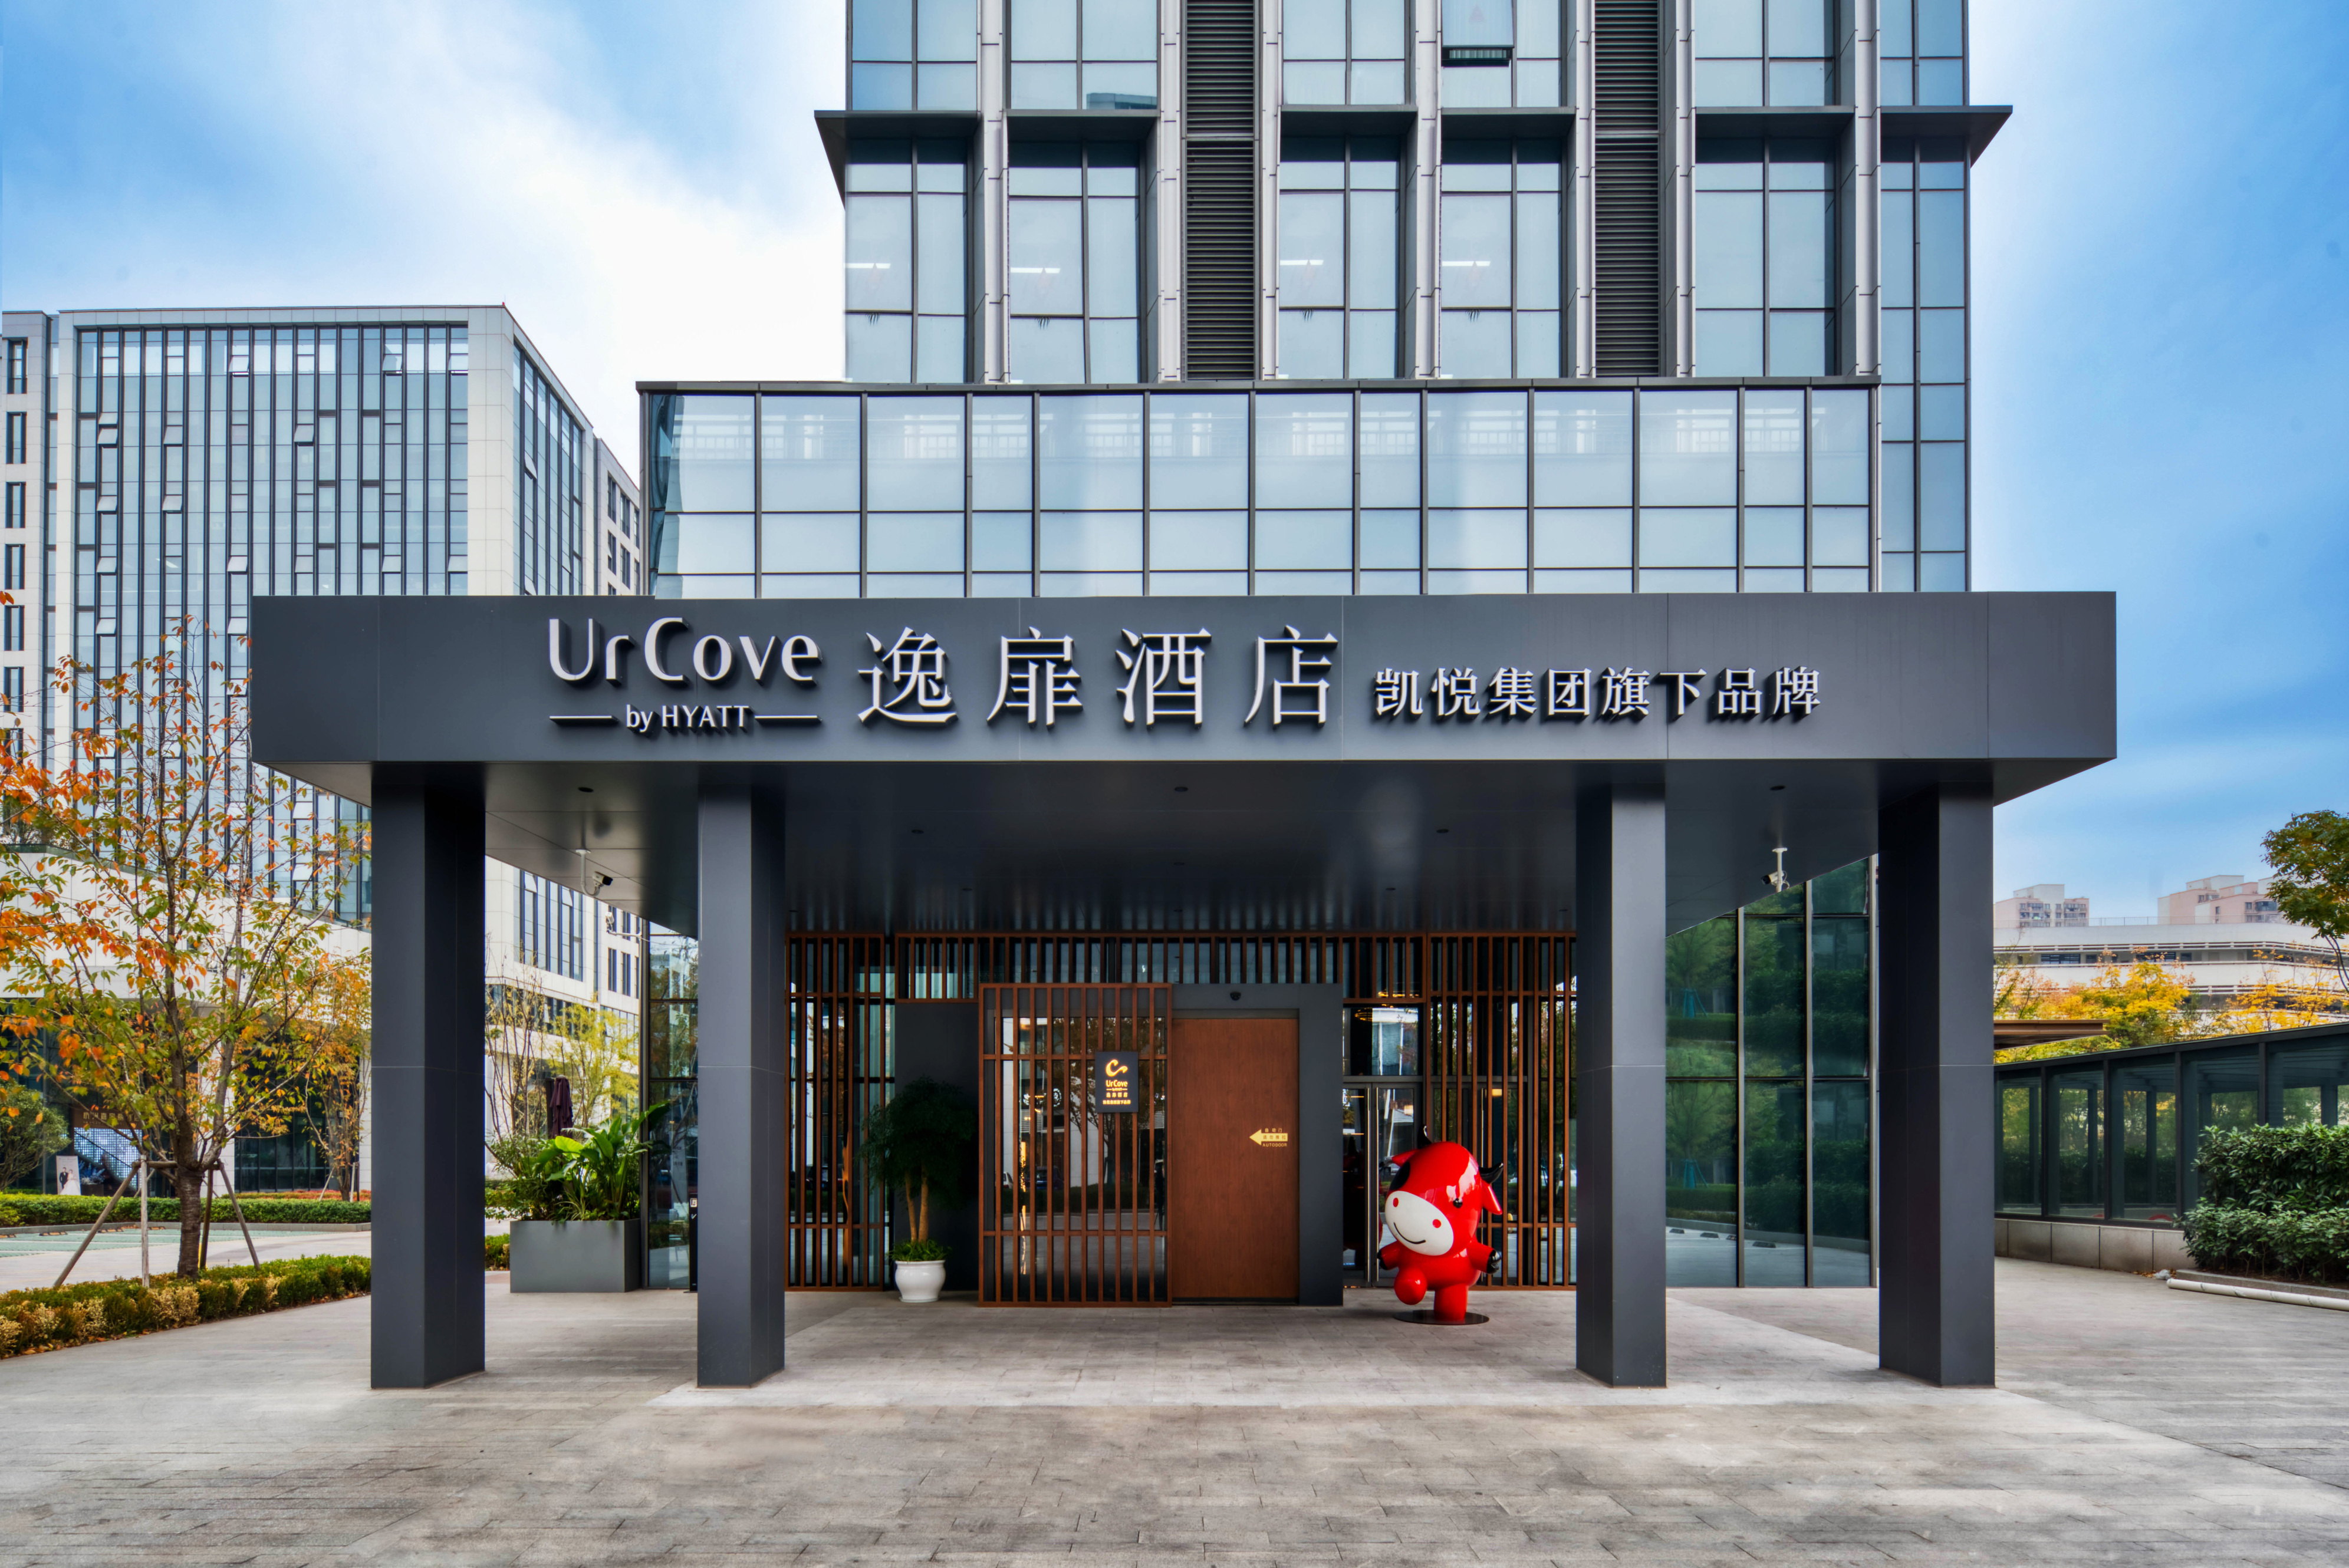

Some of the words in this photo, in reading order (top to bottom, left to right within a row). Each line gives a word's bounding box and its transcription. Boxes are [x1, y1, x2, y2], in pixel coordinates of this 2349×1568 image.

[549, 617, 822, 685] UrCove
[857, 625, 1338, 727] 逸扉酒店
[1374, 666, 1822, 717] 凯悦集团旗下品牌
[626, 704, 654, 734] by
[661, 705, 751, 731] HYATT
[1106, 1079, 1128, 1088] UrCove
